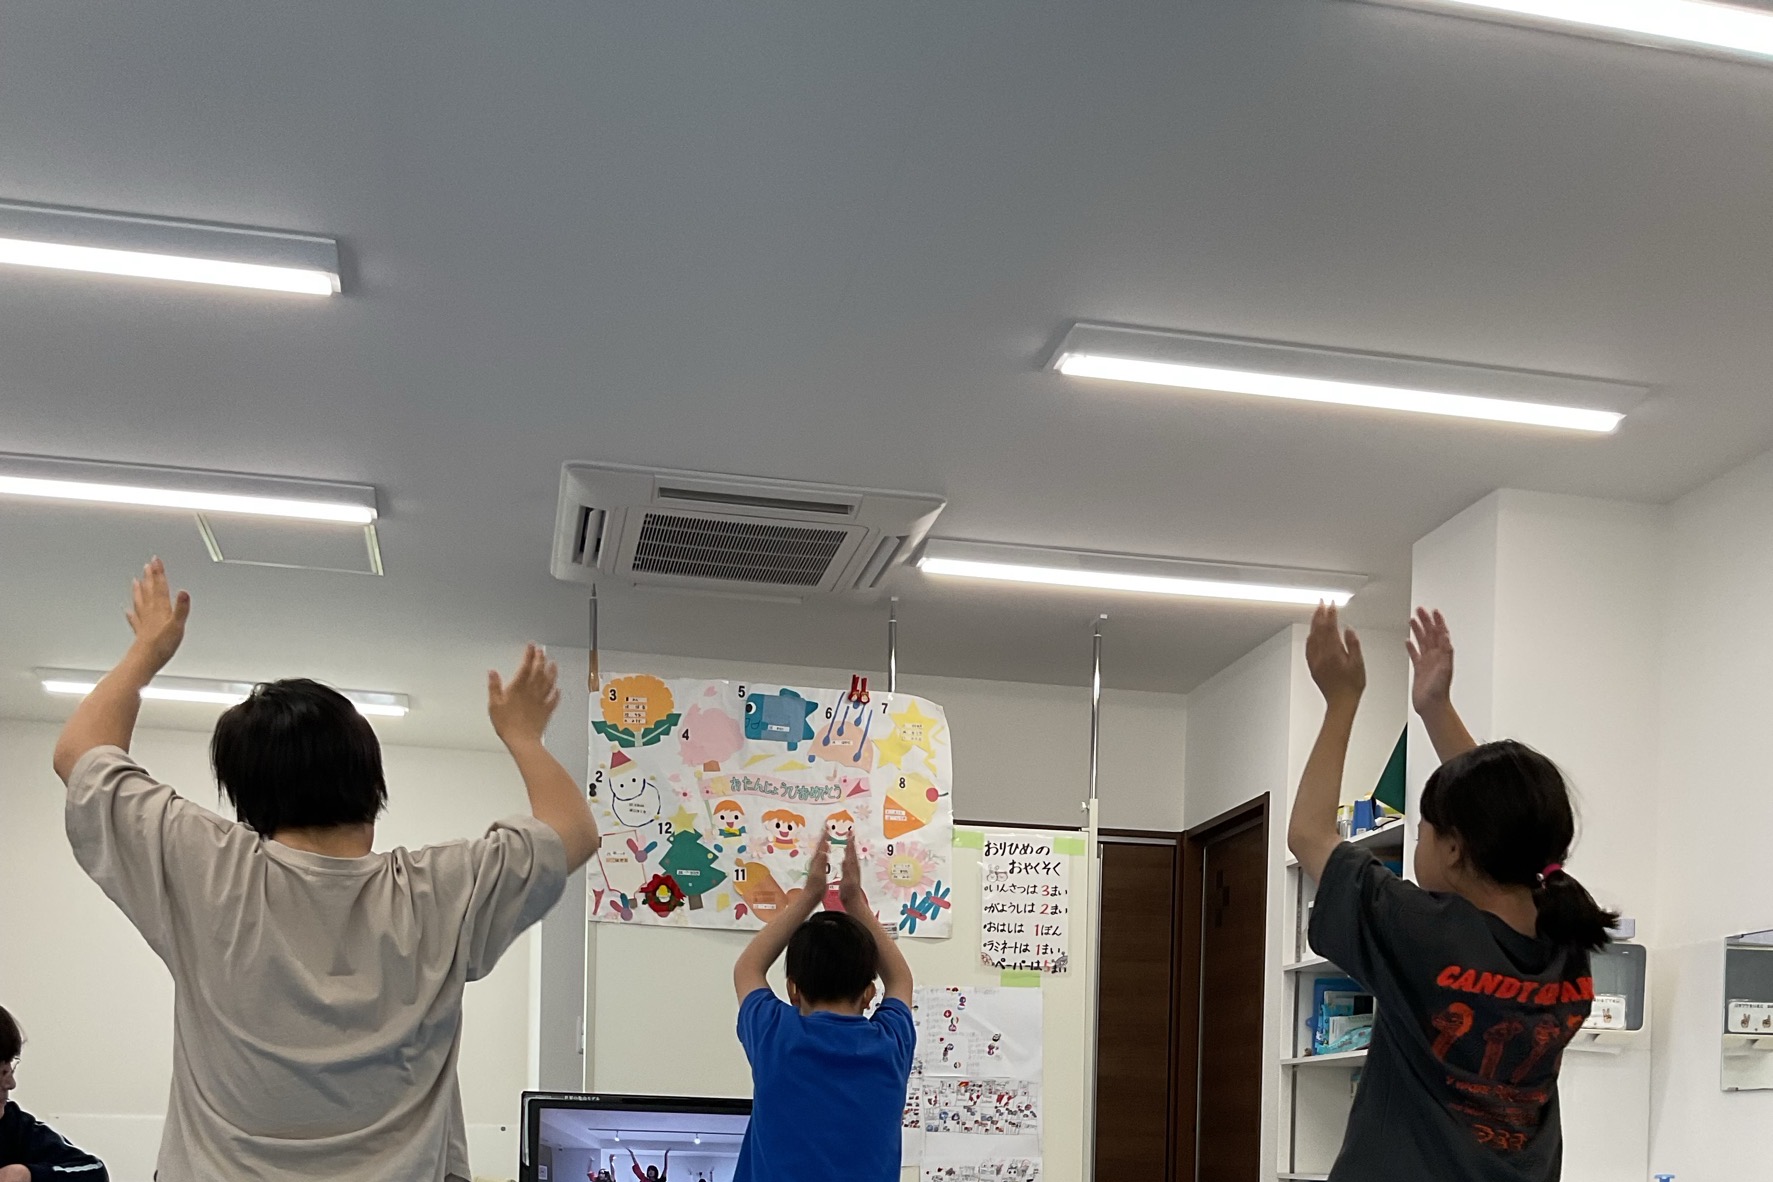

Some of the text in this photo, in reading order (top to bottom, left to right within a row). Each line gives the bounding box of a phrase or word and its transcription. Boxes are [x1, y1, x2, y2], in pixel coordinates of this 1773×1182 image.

[609, 689, 617, 701] 3
[738, 685, 746, 698] 5
[825, 707, 833, 719] 6
[881, 702, 889, 714] 7
[681, 728, 690, 741] 4
[595, 770, 603, 783] 2
[899, 777, 906, 789] 8
[658, 822, 672, 835] 12
[887, 844, 894, 857] 9
[984, 840, 1051, 857] おりひめの
[734, 868, 746, 881] 11
[1008, 859, 1061, 877] おやくそく
